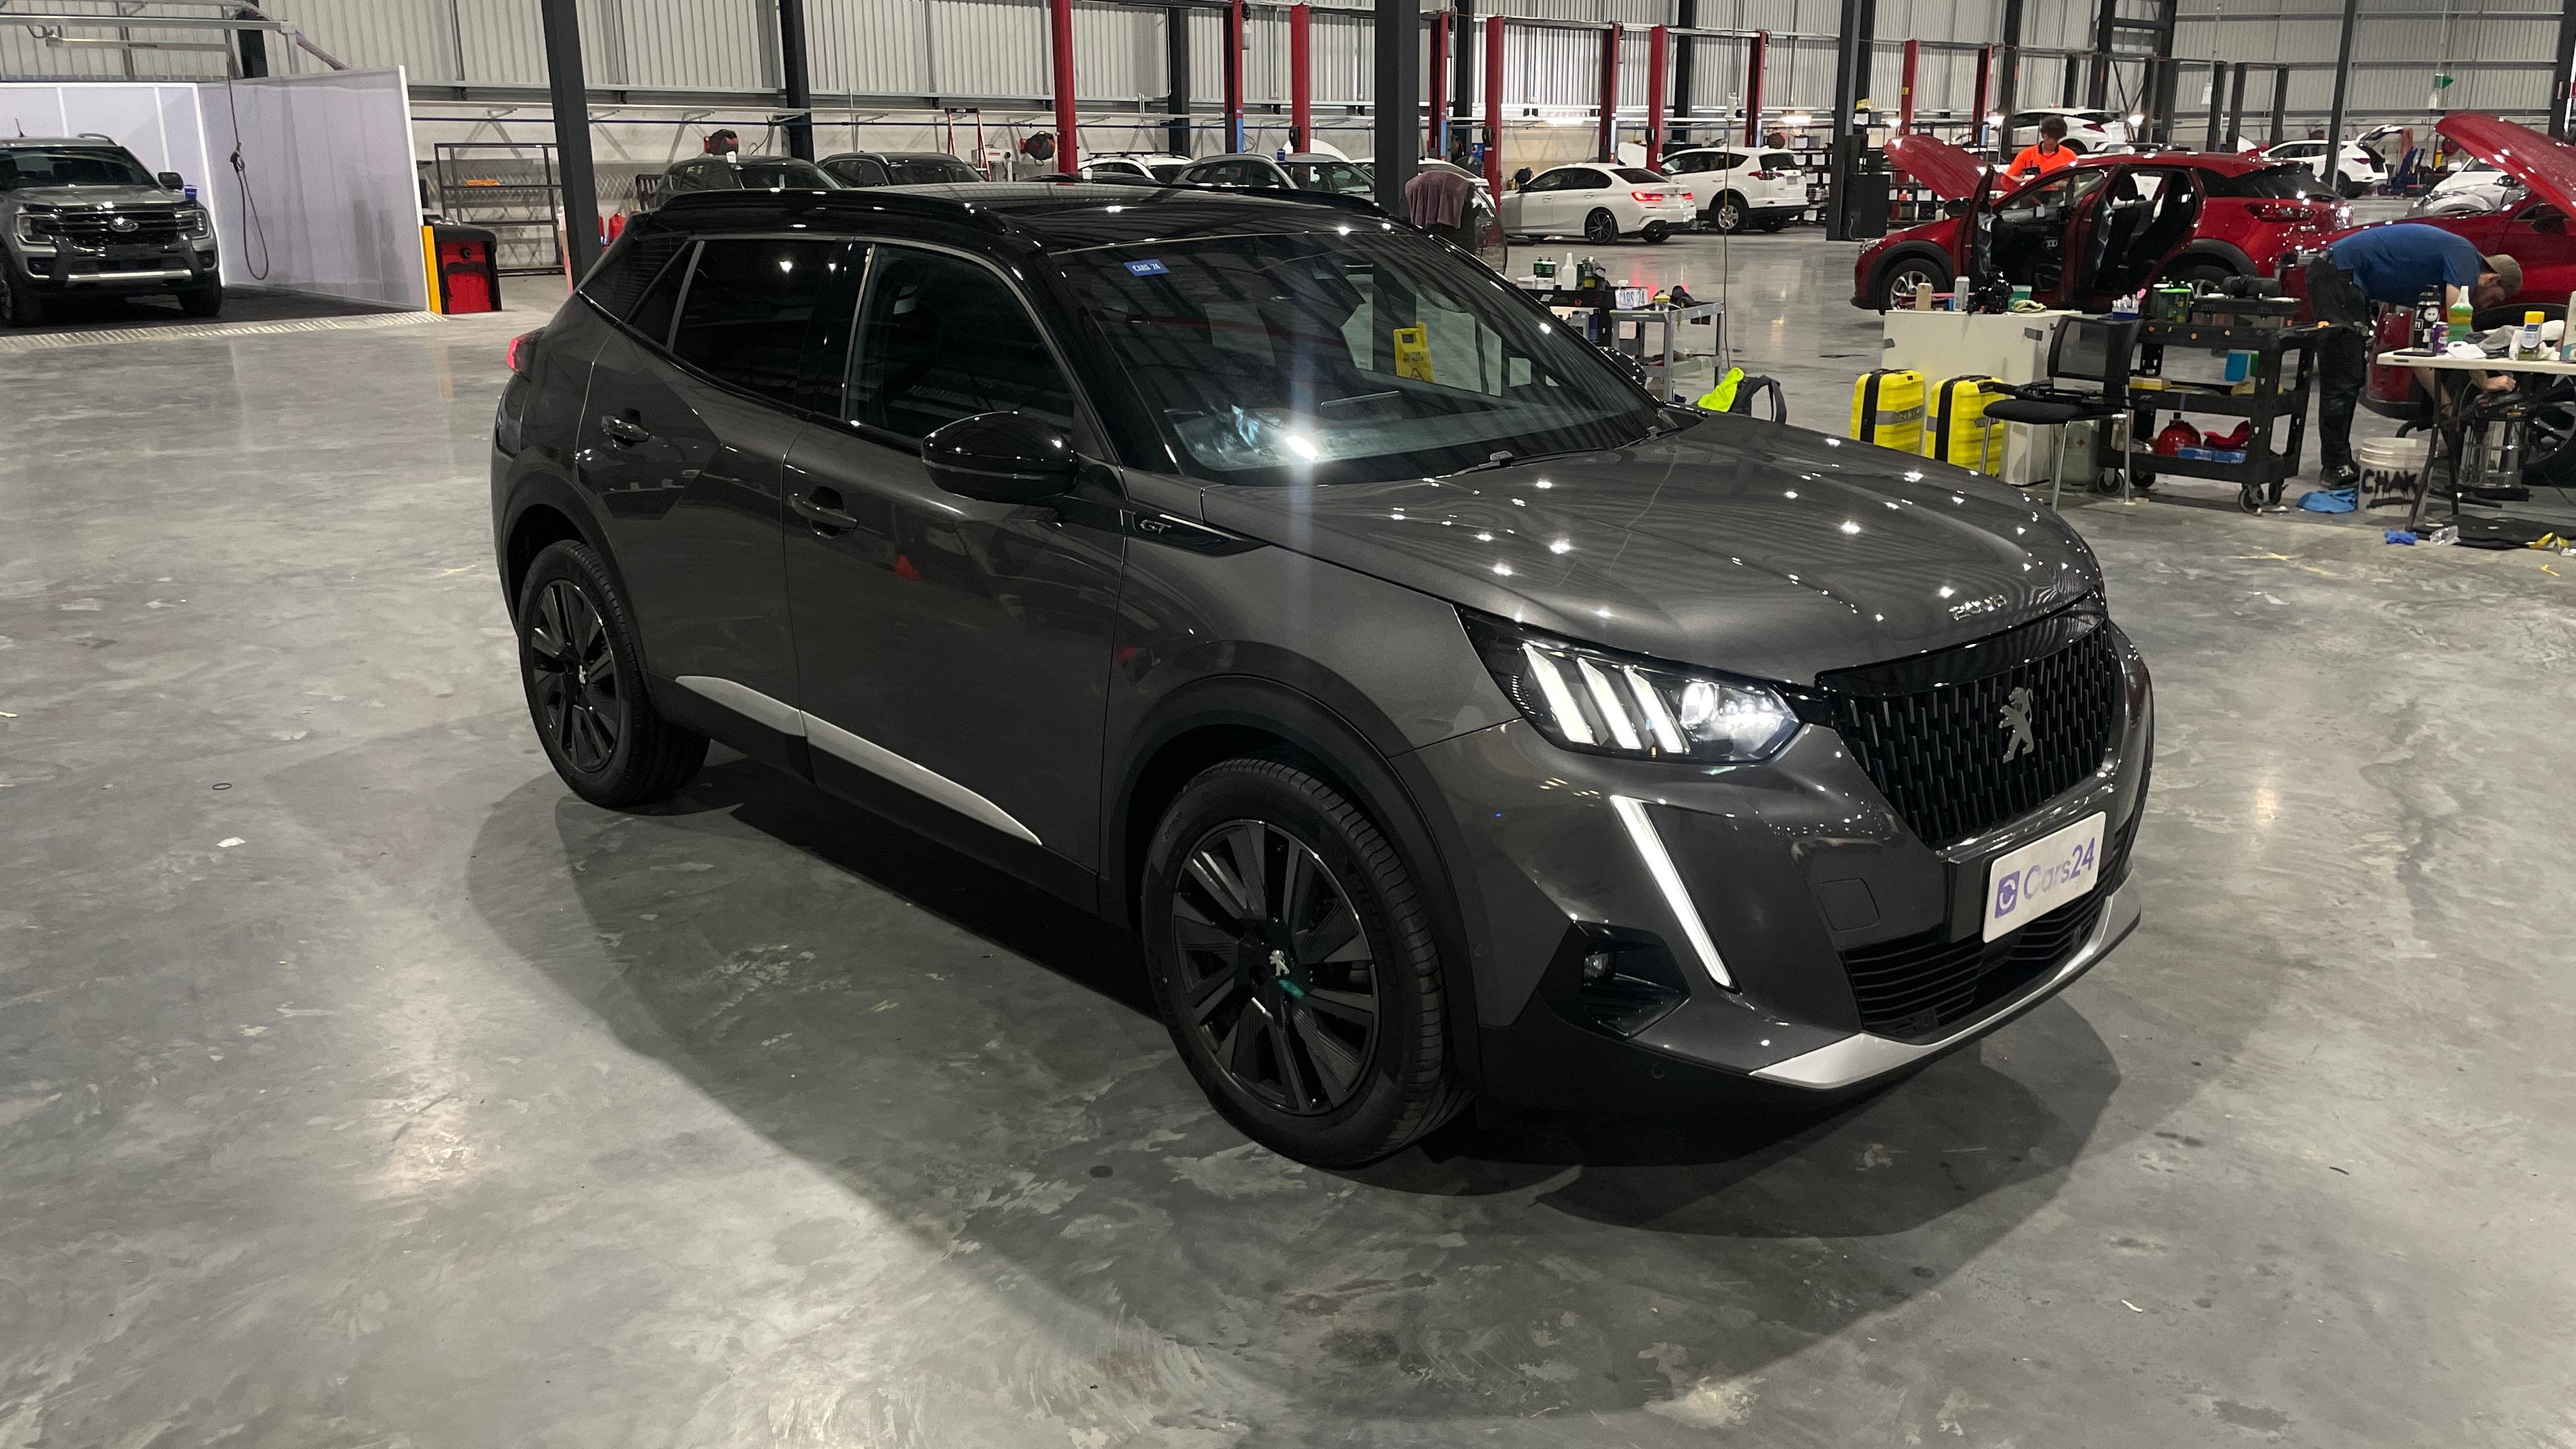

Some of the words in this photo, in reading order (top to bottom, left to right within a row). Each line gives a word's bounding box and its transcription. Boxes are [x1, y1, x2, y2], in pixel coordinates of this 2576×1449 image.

[1637, 290, 1645, 307] 24
[1140, 519, 1172, 535] GT
[2023, 836, 2096, 900] Cars24
